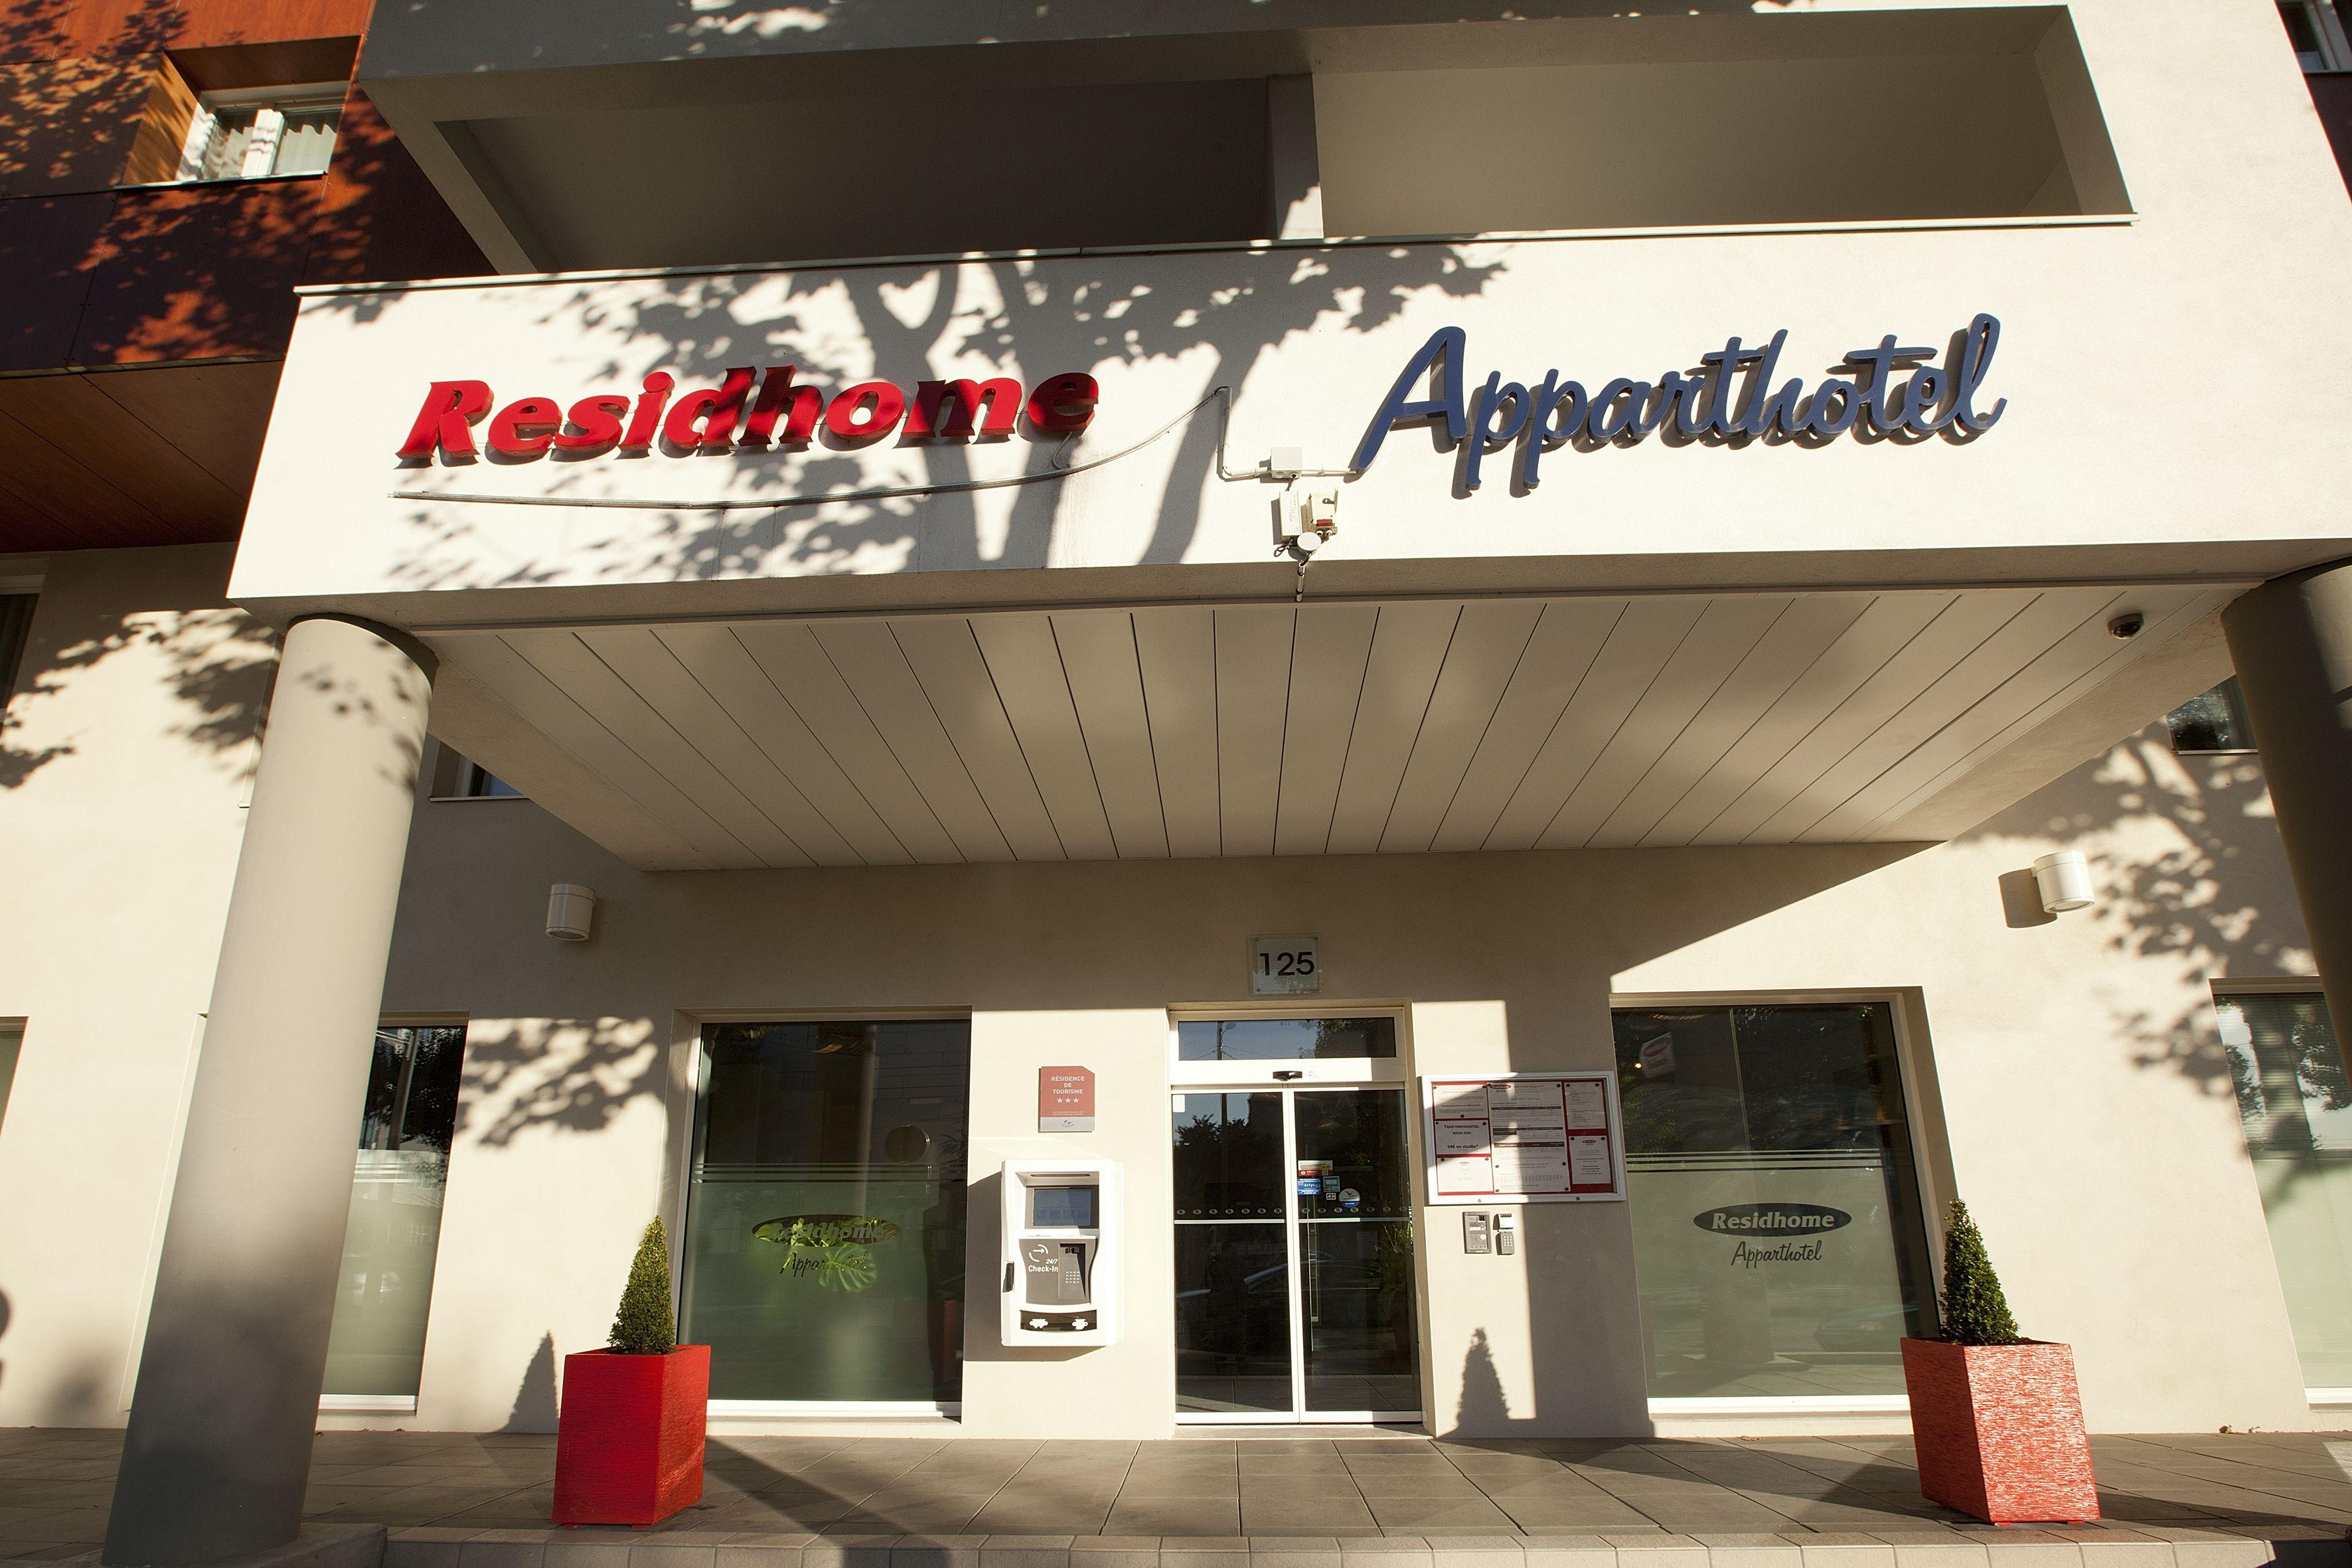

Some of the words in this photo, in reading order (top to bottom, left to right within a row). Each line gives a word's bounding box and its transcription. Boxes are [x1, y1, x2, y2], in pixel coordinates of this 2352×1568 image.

[394, 364, 1099, 460] Residhome
[1356, 313, 2008, 491] Apparthotel
[1259, 951, 1315, 976] 125
[1711, 1212, 1835, 1229] Residhome
[1731, 1239, 1822, 1269] Apparthotel
